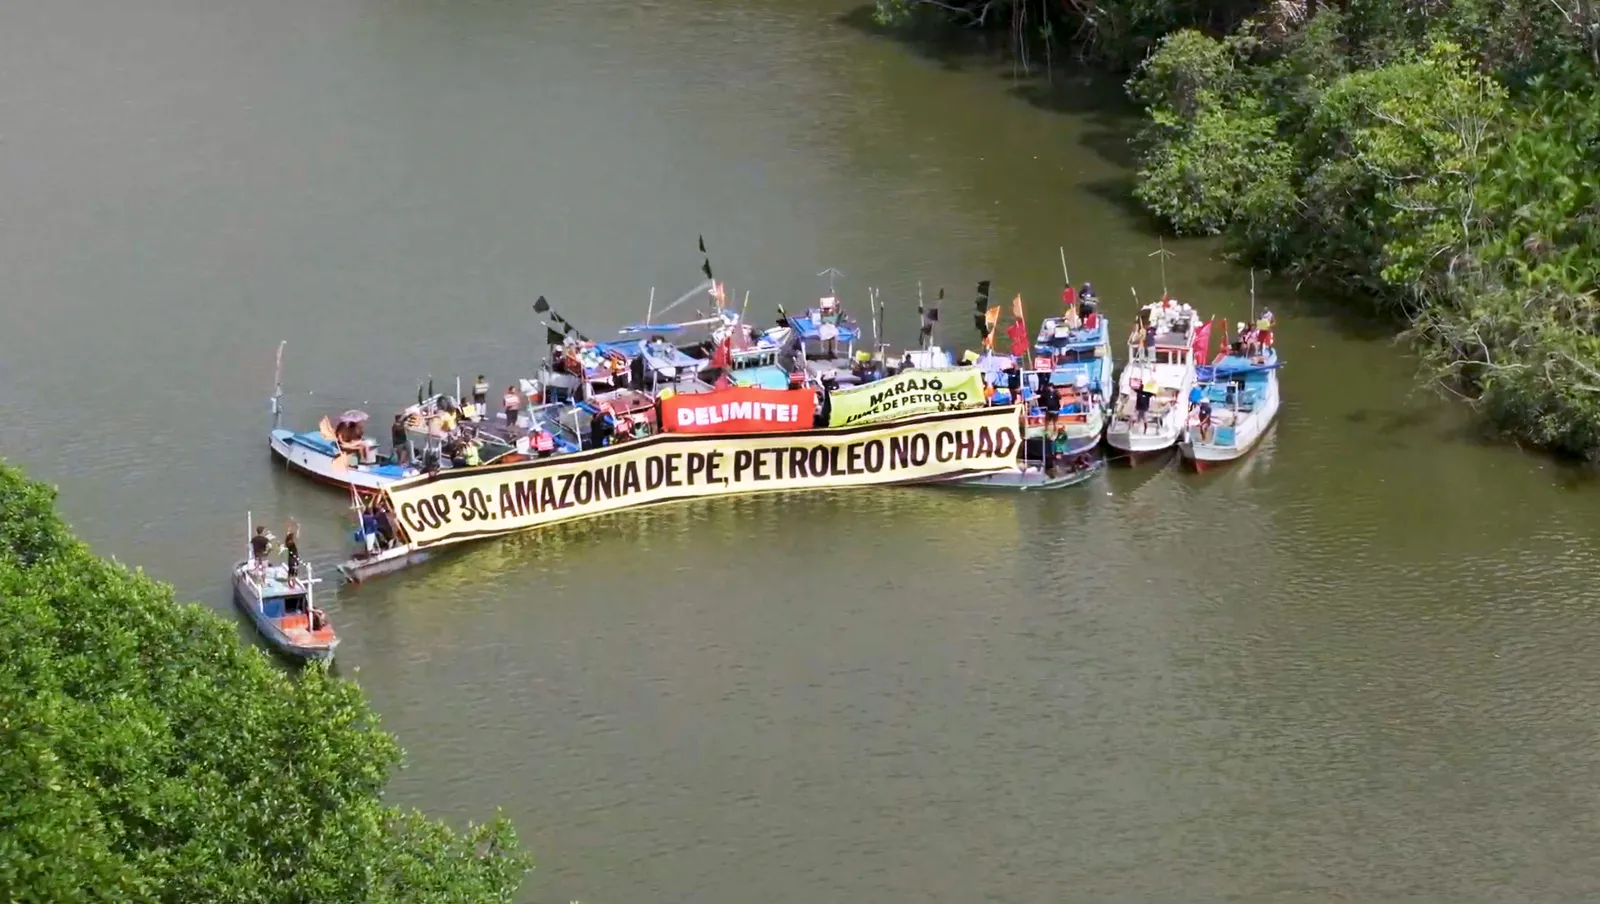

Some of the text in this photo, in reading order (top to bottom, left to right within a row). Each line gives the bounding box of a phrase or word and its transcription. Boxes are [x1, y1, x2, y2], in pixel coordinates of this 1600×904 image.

[870, 376, 943, 407] MARAJÓ
[883, 399, 898, 411] DE
[902, 391, 967, 406] PETRÓLEO
[677, 401, 798, 427] DELIMITE!
[401, 493, 451, 532] COP
[452, 486, 497, 521] 30:
[645, 453, 682, 491] DE
[687, 449, 729, 488] PÉ,
[889, 432, 930, 471] NO
